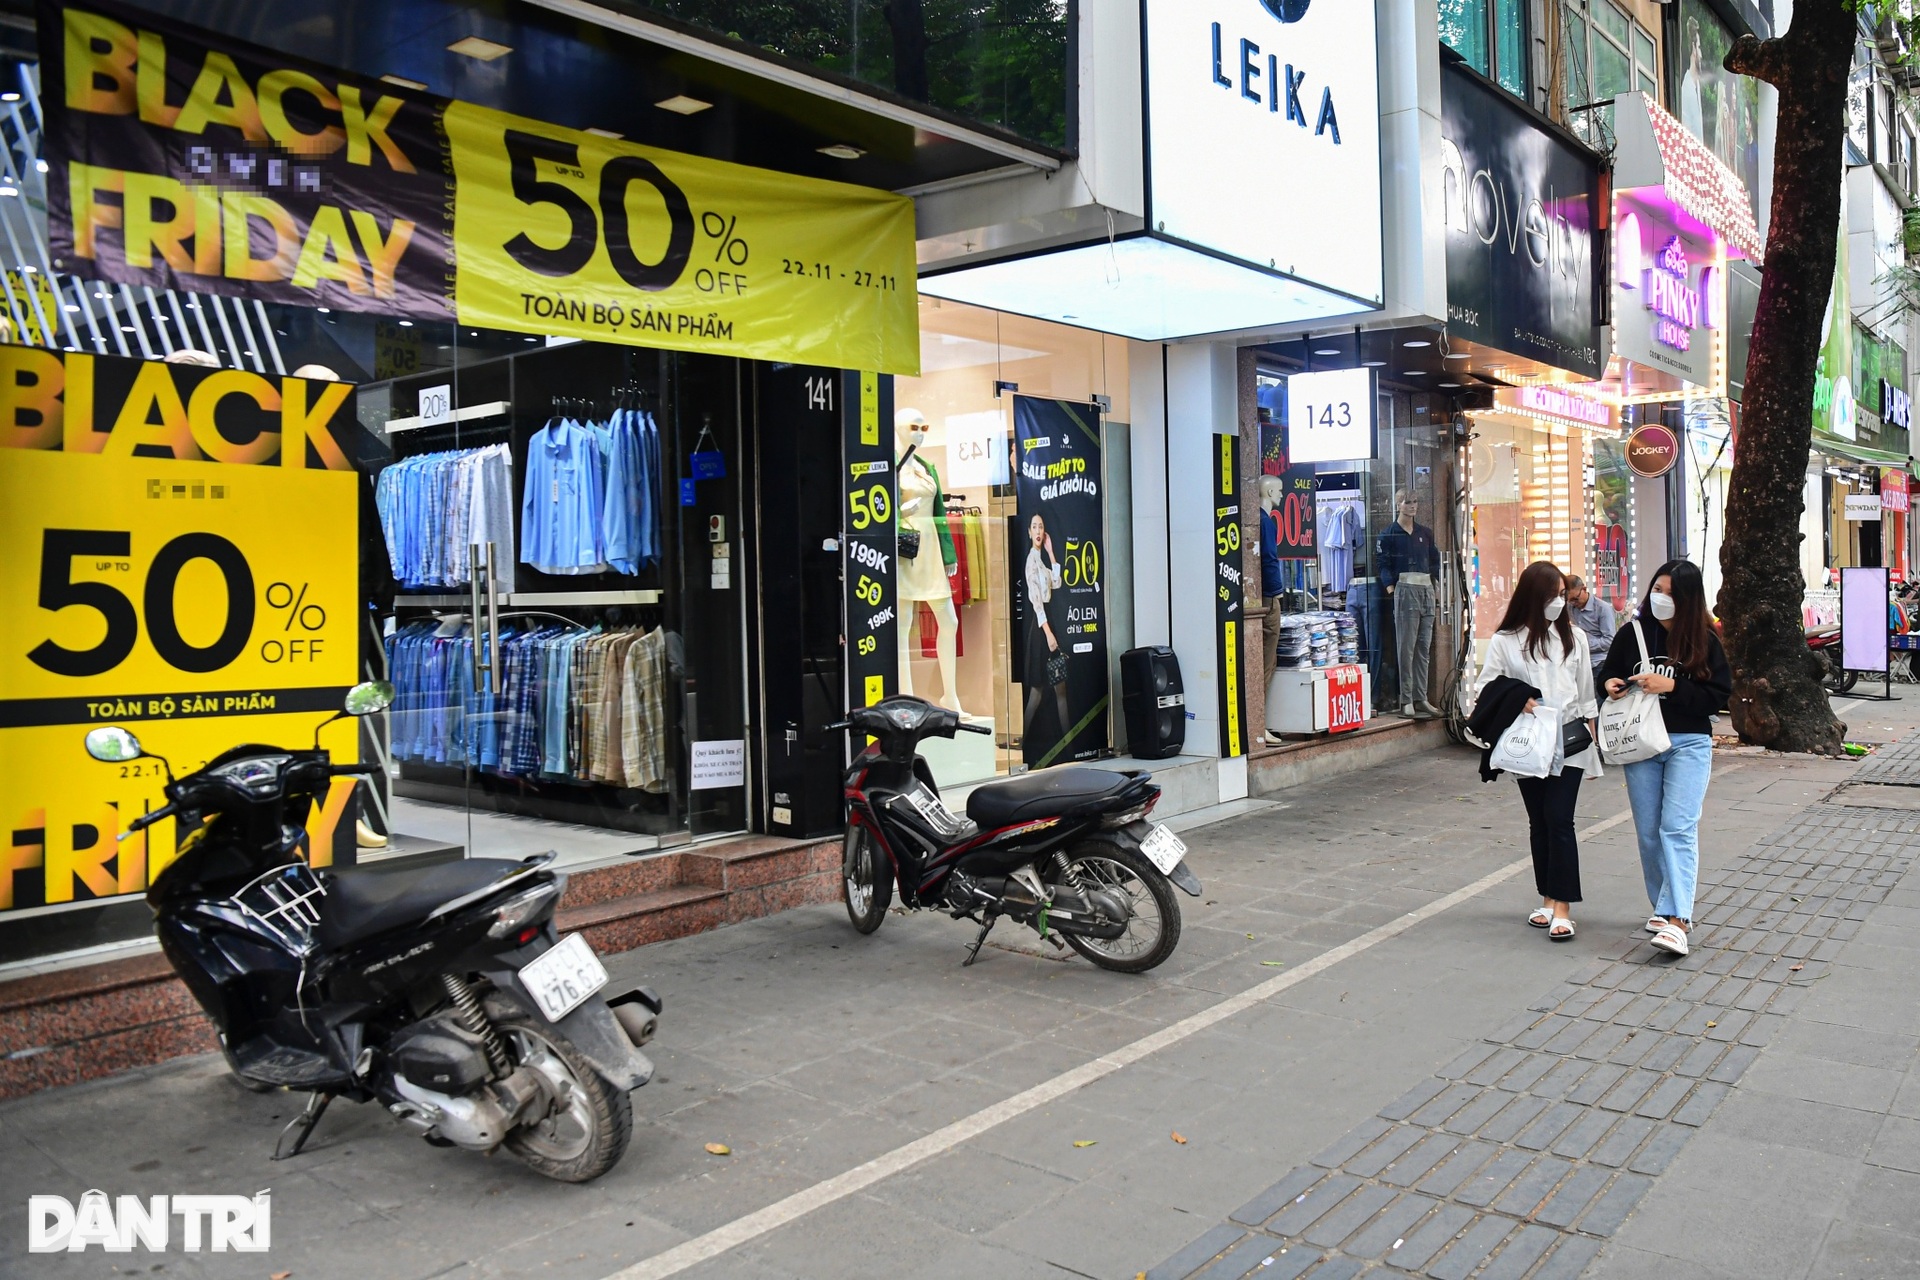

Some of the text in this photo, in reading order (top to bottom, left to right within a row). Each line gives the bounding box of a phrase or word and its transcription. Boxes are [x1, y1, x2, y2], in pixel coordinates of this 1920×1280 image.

[62, 8, 417, 175] BLACK
[1212, 22, 1341, 145] LEIKA
[556, 165, 584, 179] UP TO
[67, 161, 416, 299] FRIDAY
[695, 268, 748, 297] OFF
[782, 258, 831, 280] 22.11
[854, 271, 896, 292] 27.11
[1652, 268, 1700, 330] PINKY
[521, 292, 733, 340] TOÀN BỘ SẢN PHẨM
[1663, 321, 1691, 352] HOUSE
[805, 376, 833, 411] 141
[0, 346, 355, 471] BLACK
[1306, 402, 1352, 429] 143
[1632, 446, 1670, 456] JOCKEY
[852, 461, 887, 473] BLACK LEIKA
[1022, 457, 1086, 480] SALE THẬT TO
[1040, 480, 1058, 500] GIÁ
[1083, 478, 1097, 495] LO
[1294, 478, 1311, 489] SALE
[1300, 529, 1313, 547] off
[95, 562, 130, 571] UP TO
[850, 540, 890, 574] 199K
[1218, 561, 1241, 586] 199K
[867, 606, 895, 630] 199K
[1067, 605, 1097, 621] ÁO LEN
[261, 639, 324, 664] OFF
[87, 692, 275, 718] TOÀN BỘ SẢN PHẨM
[1332, 690, 1362, 727] 130k
[1510, 736, 1530, 747] may
[120, 765, 161, 778] 22.1
[0, 777, 358, 909] FRIY
